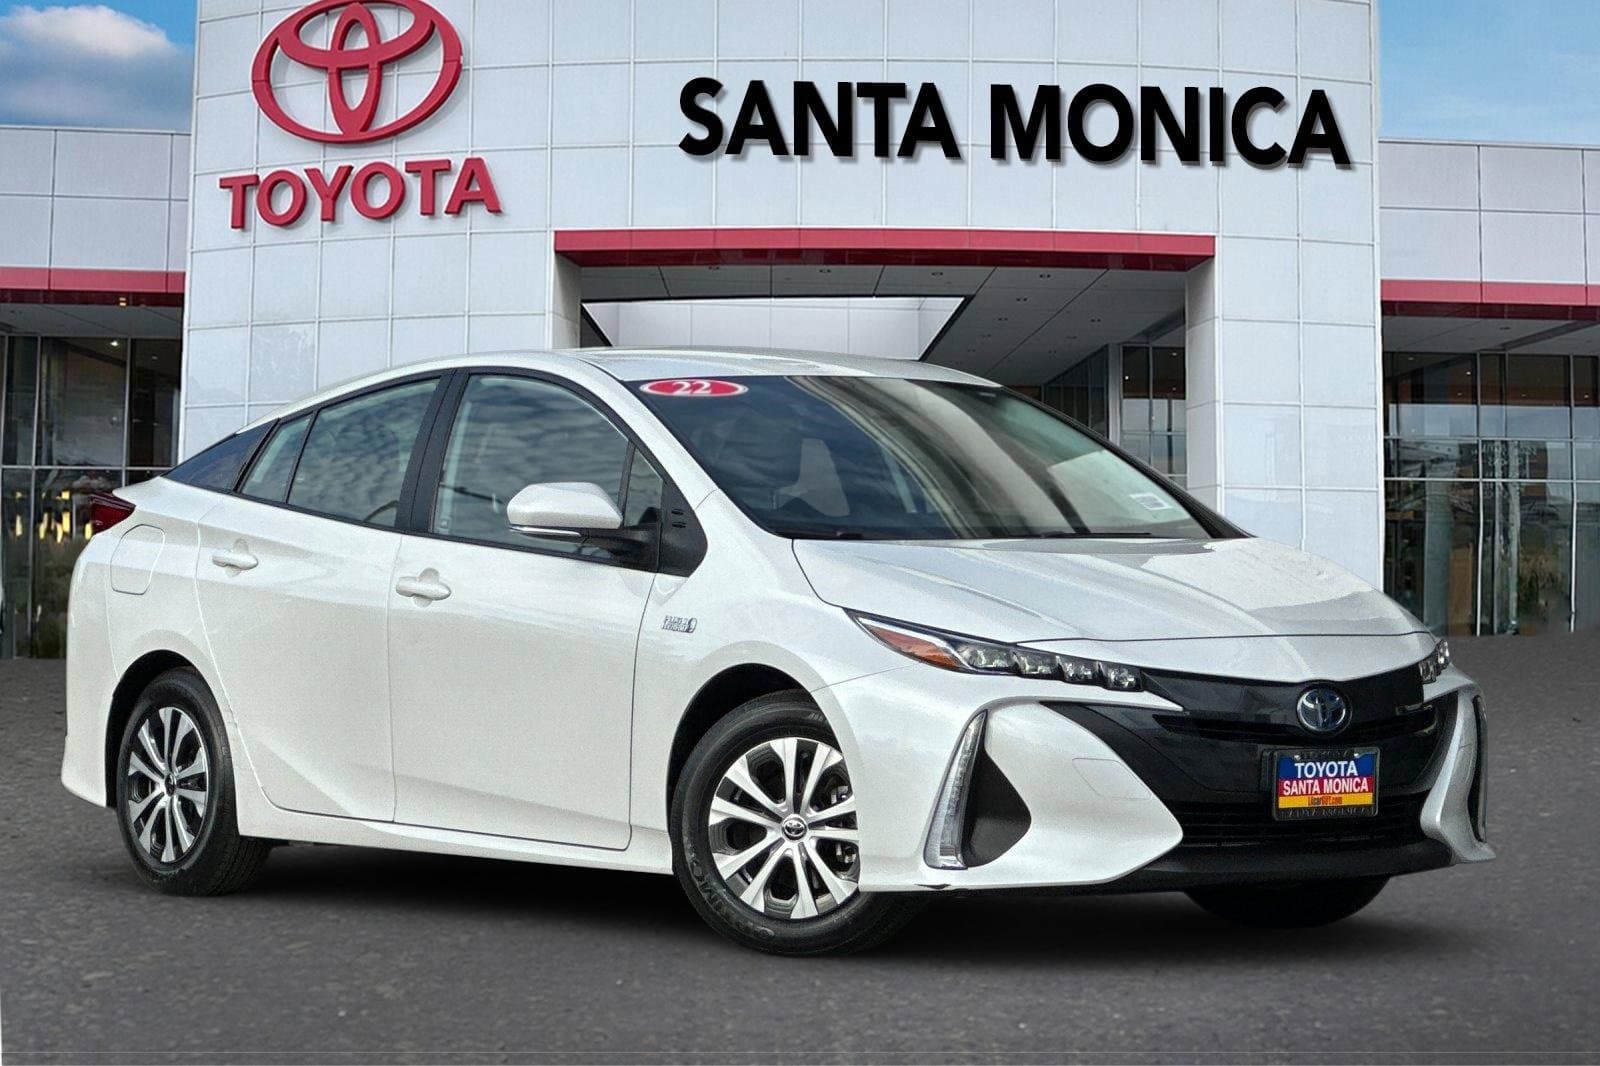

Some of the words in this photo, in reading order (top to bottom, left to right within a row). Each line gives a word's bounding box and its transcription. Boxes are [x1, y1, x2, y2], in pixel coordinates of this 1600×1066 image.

[678, 77, 960, 162] SANTA
[989, 83, 1352, 168] MONICA
[219, 157, 503, 230] TOYOTA
[672, 381, 712, 395] 22
[1294, 760, 1358, 779] TOYOTA
[1283, 780, 1321, 796] SANTA
[1323, 777, 1369, 794] MONICA
